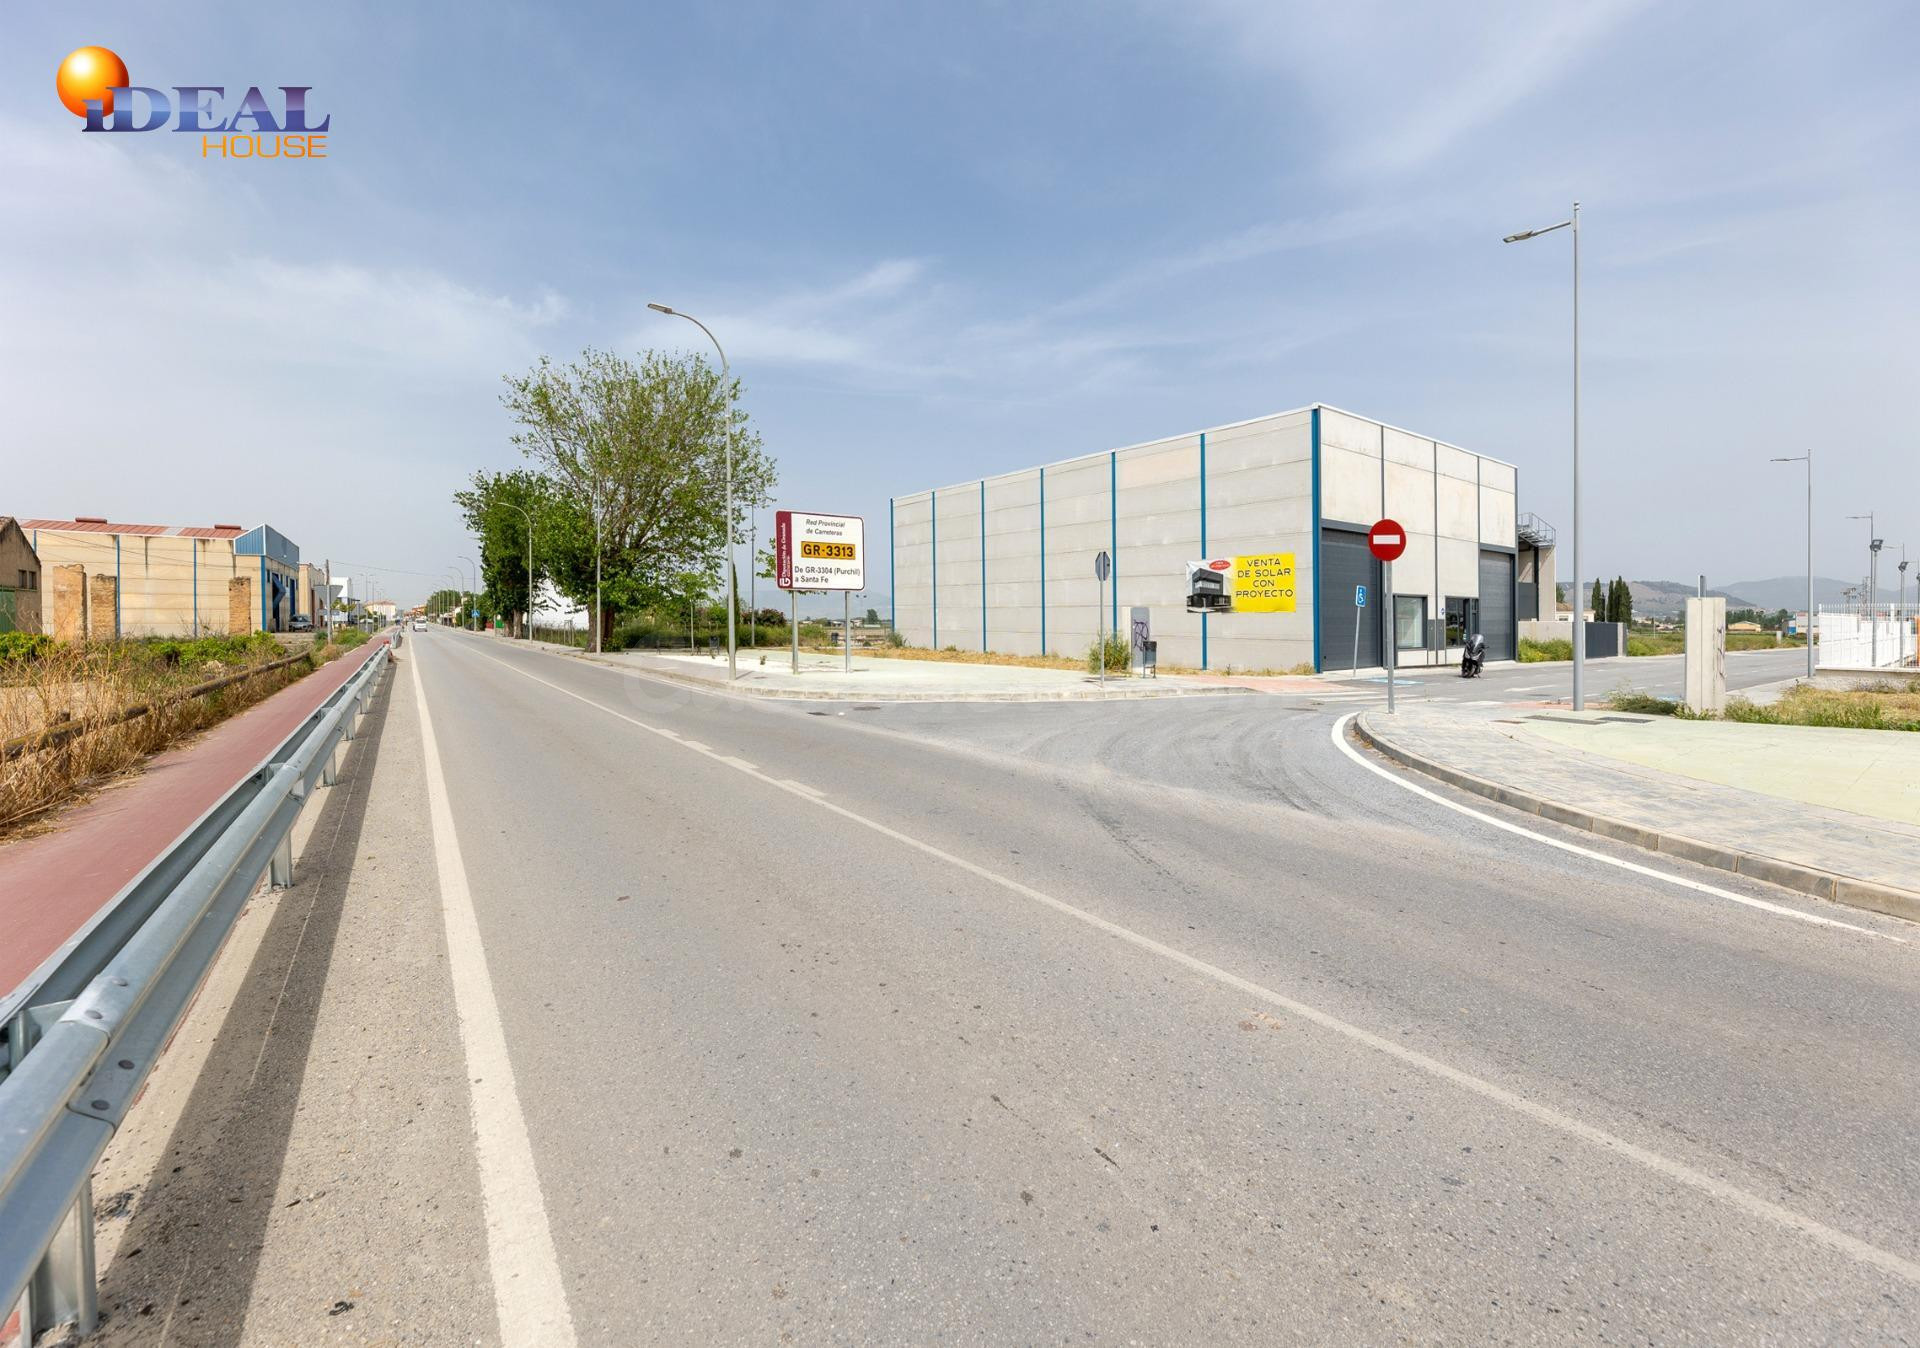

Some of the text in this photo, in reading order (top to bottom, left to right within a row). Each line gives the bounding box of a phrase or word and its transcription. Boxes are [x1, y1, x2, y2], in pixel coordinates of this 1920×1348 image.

[818, 520, 846, 528] Provincial
[814, 528, 843, 536] Carreteras
[803, 544, 854, 557] GR-3313
[1247, 558, 1281, 567] VENTA
[805, 566, 833, 574] GR-3304
[834, 567, 861, 576] (Purchil)
[1237, 568, 1291, 578] DE SOLAR
[800, 575, 819, 583] Santa
[1252, 579, 1275, 587] CON
[1235, 589, 1294, 598] PROYECTO
